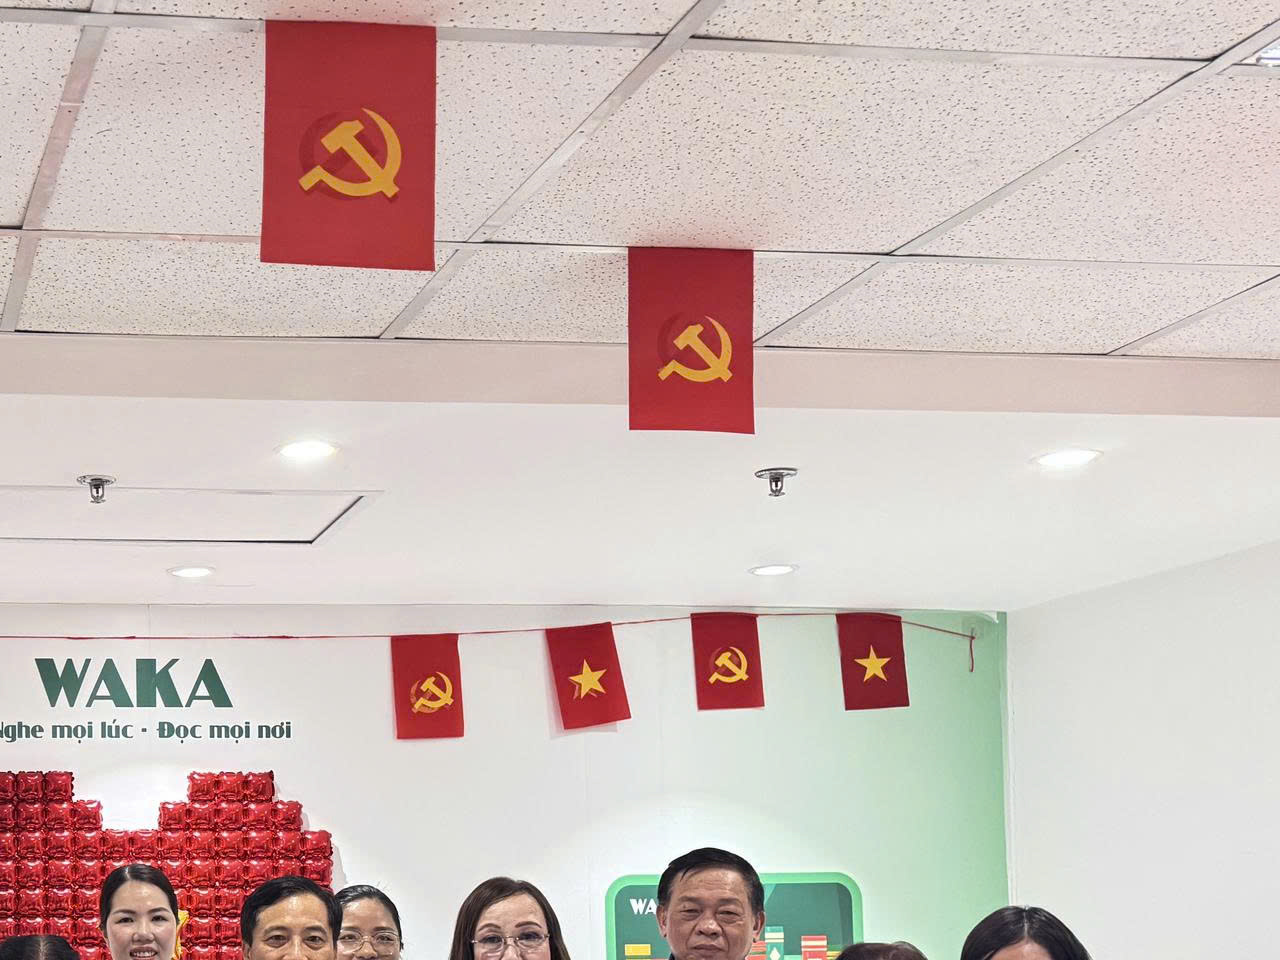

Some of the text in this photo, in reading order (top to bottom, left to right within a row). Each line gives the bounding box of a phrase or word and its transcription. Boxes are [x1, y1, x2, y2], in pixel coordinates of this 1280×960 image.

[34, 658, 233, 707] WAKA
[51, 721, 93, 744] mọi
[100, 718, 134, 739] lúc
[156, 721, 202, 744] Đọc
[209, 721, 251, 744] mọi
[257, 721, 292, 739] nơi
[629, 898, 657, 915] WA
